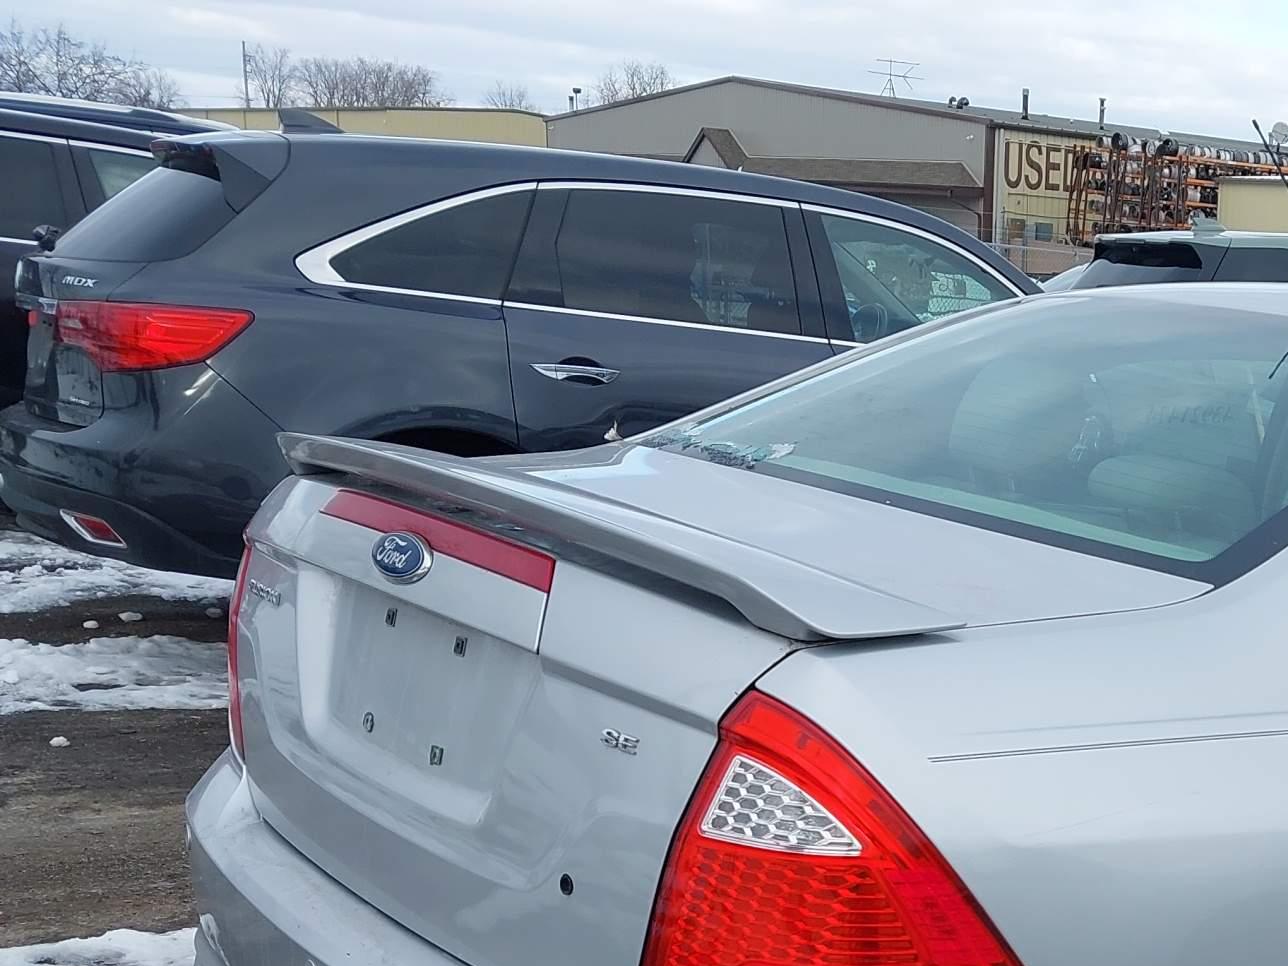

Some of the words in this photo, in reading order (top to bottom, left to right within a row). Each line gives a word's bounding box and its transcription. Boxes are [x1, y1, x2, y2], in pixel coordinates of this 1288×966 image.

[62, 275, 99, 288] MDX
[376, 535, 412, 569] Ford
[600, 727, 640, 756] SE
